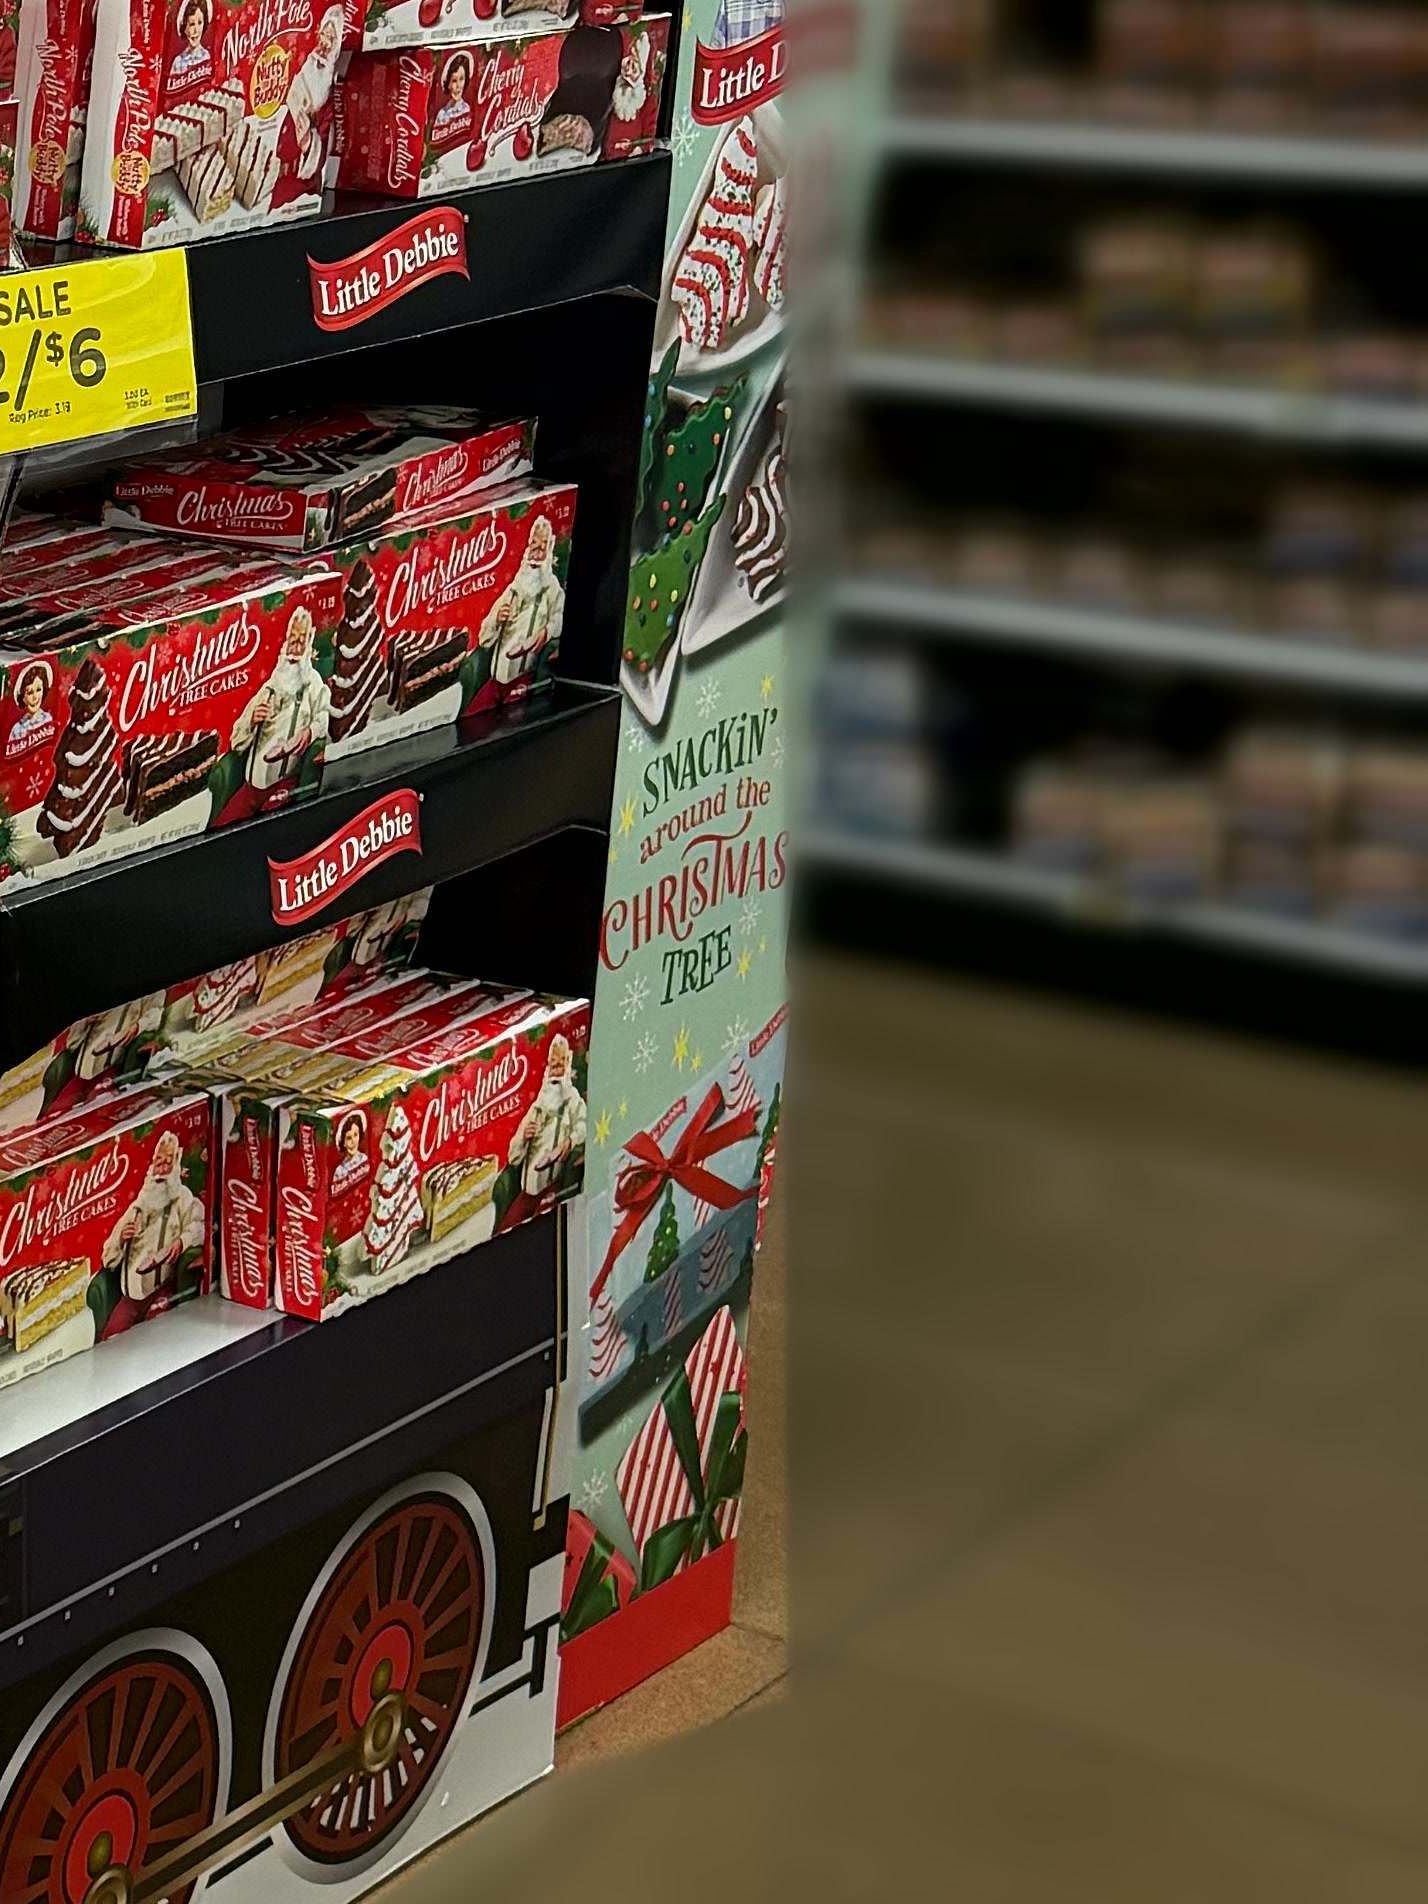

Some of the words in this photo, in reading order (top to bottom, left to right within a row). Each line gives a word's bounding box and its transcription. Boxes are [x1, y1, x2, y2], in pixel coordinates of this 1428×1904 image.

[700, 55, 765, 111] Little
[317, 264, 380, 317] Little
[384, 227, 460, 284] Debbie
[277, 858, 338, 913] Little
[340, 808, 414, 869] Debbie
[639, 783, 728, 865] around
[736, 776, 771, 810] the
[598, 810, 790, 971] CHRISTMAS
[660, 925, 732, 1006] TREE
